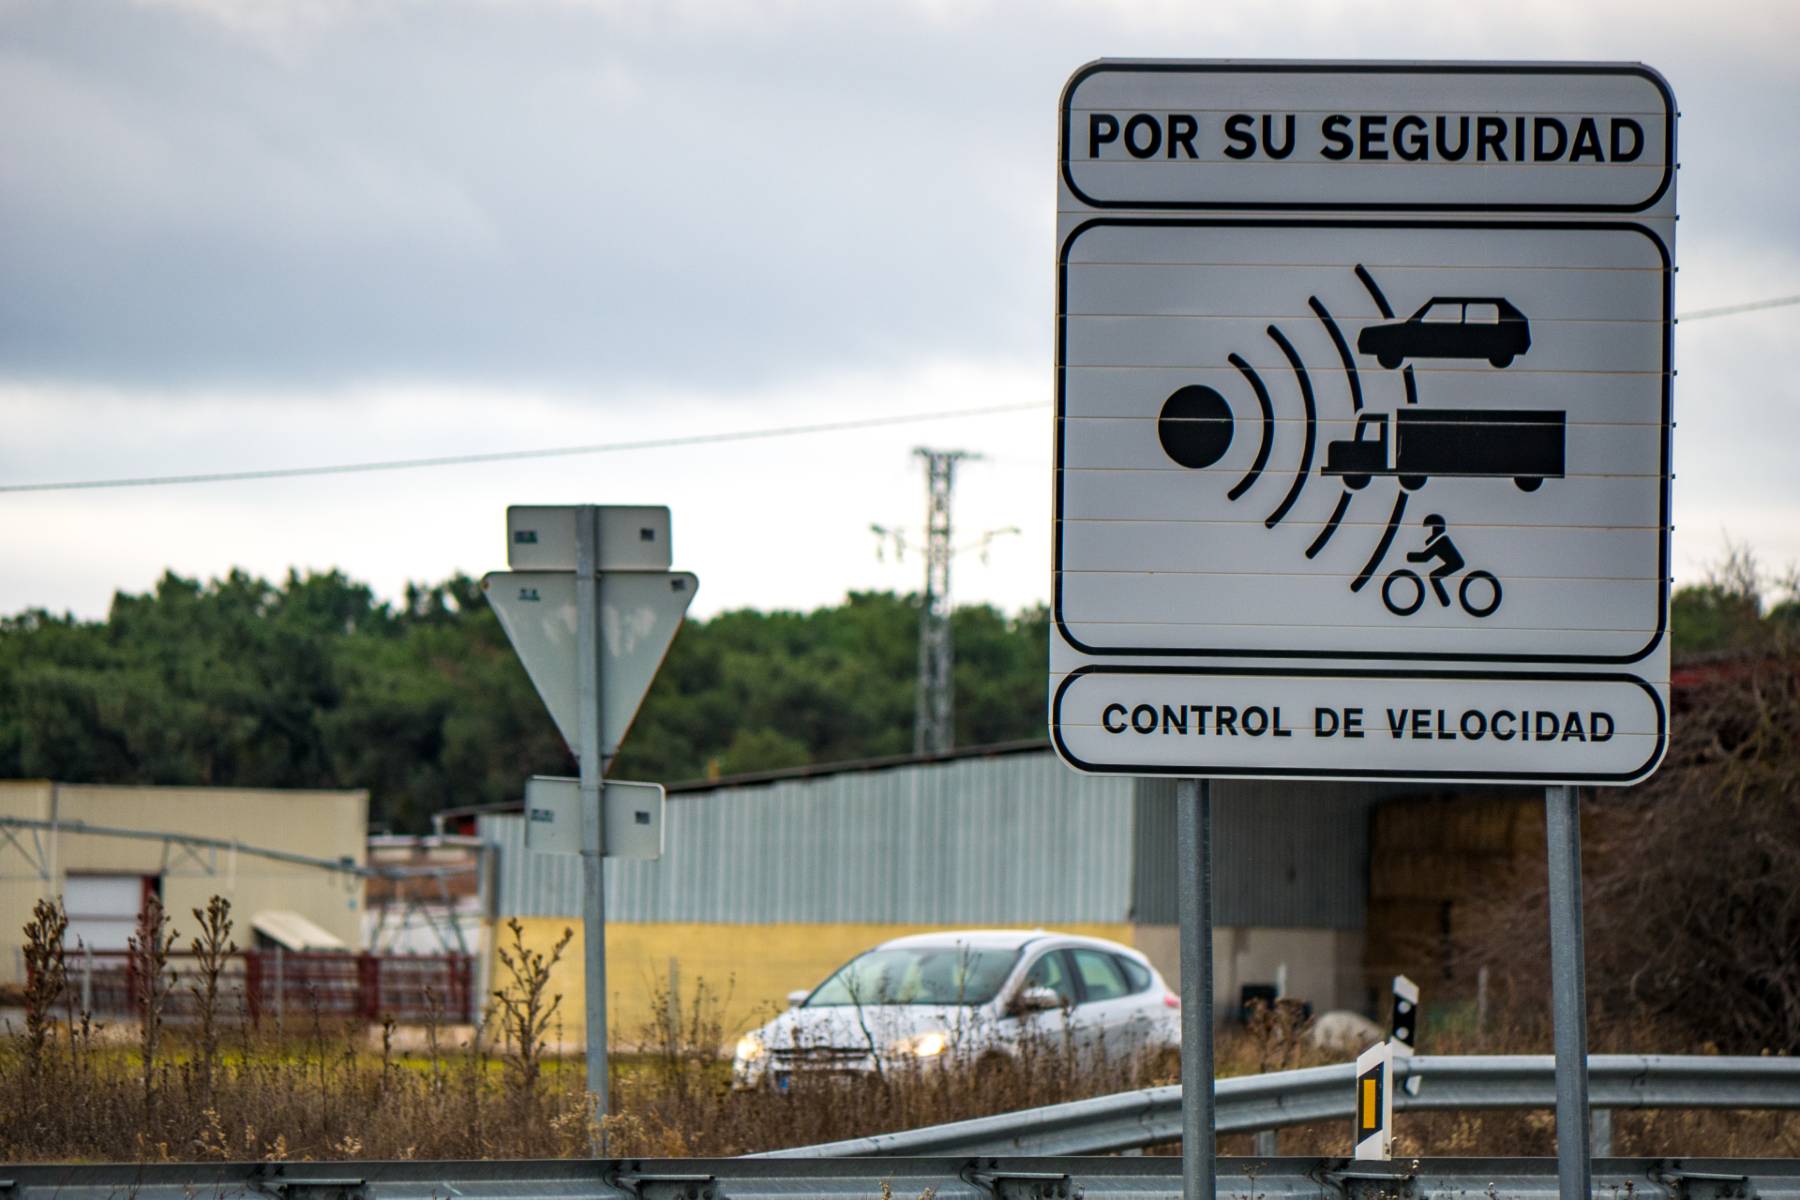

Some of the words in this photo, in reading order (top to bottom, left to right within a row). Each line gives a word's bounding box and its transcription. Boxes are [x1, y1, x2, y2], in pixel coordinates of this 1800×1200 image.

[1089, 113, 1199, 160] POR
[1224, 114, 1296, 160] SU
[1320, 115, 1645, 162] SEGURIDAD
[1102, 702, 1292, 736] CONTROL
[1315, 707, 1364, 738] DE
[1387, 708, 1615, 742] VELOCIDAD
